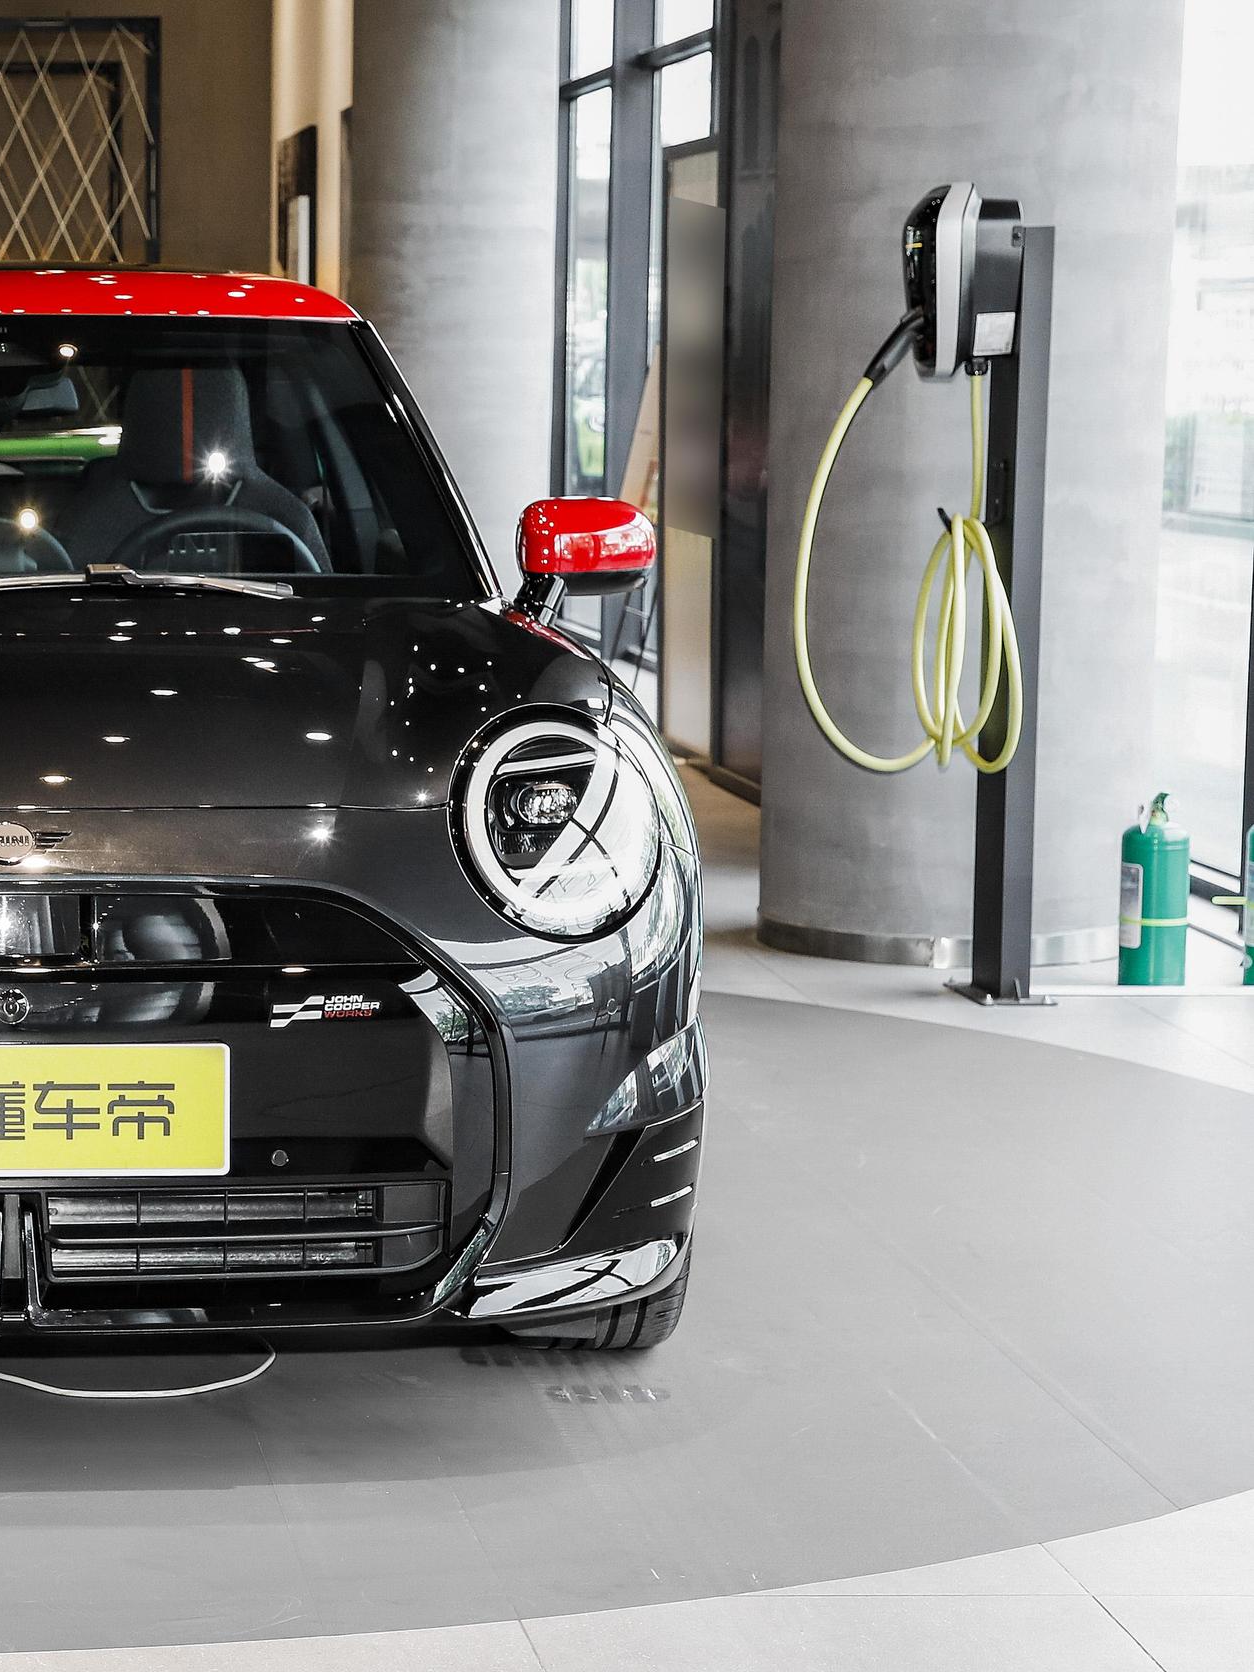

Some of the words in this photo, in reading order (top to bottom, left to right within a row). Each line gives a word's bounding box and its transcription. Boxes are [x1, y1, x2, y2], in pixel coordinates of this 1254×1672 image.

[325, 995, 364, 1004] JOHN
[324, 1001, 381, 1012] COOPER
[324, 1009, 373, 1018] WORKS
